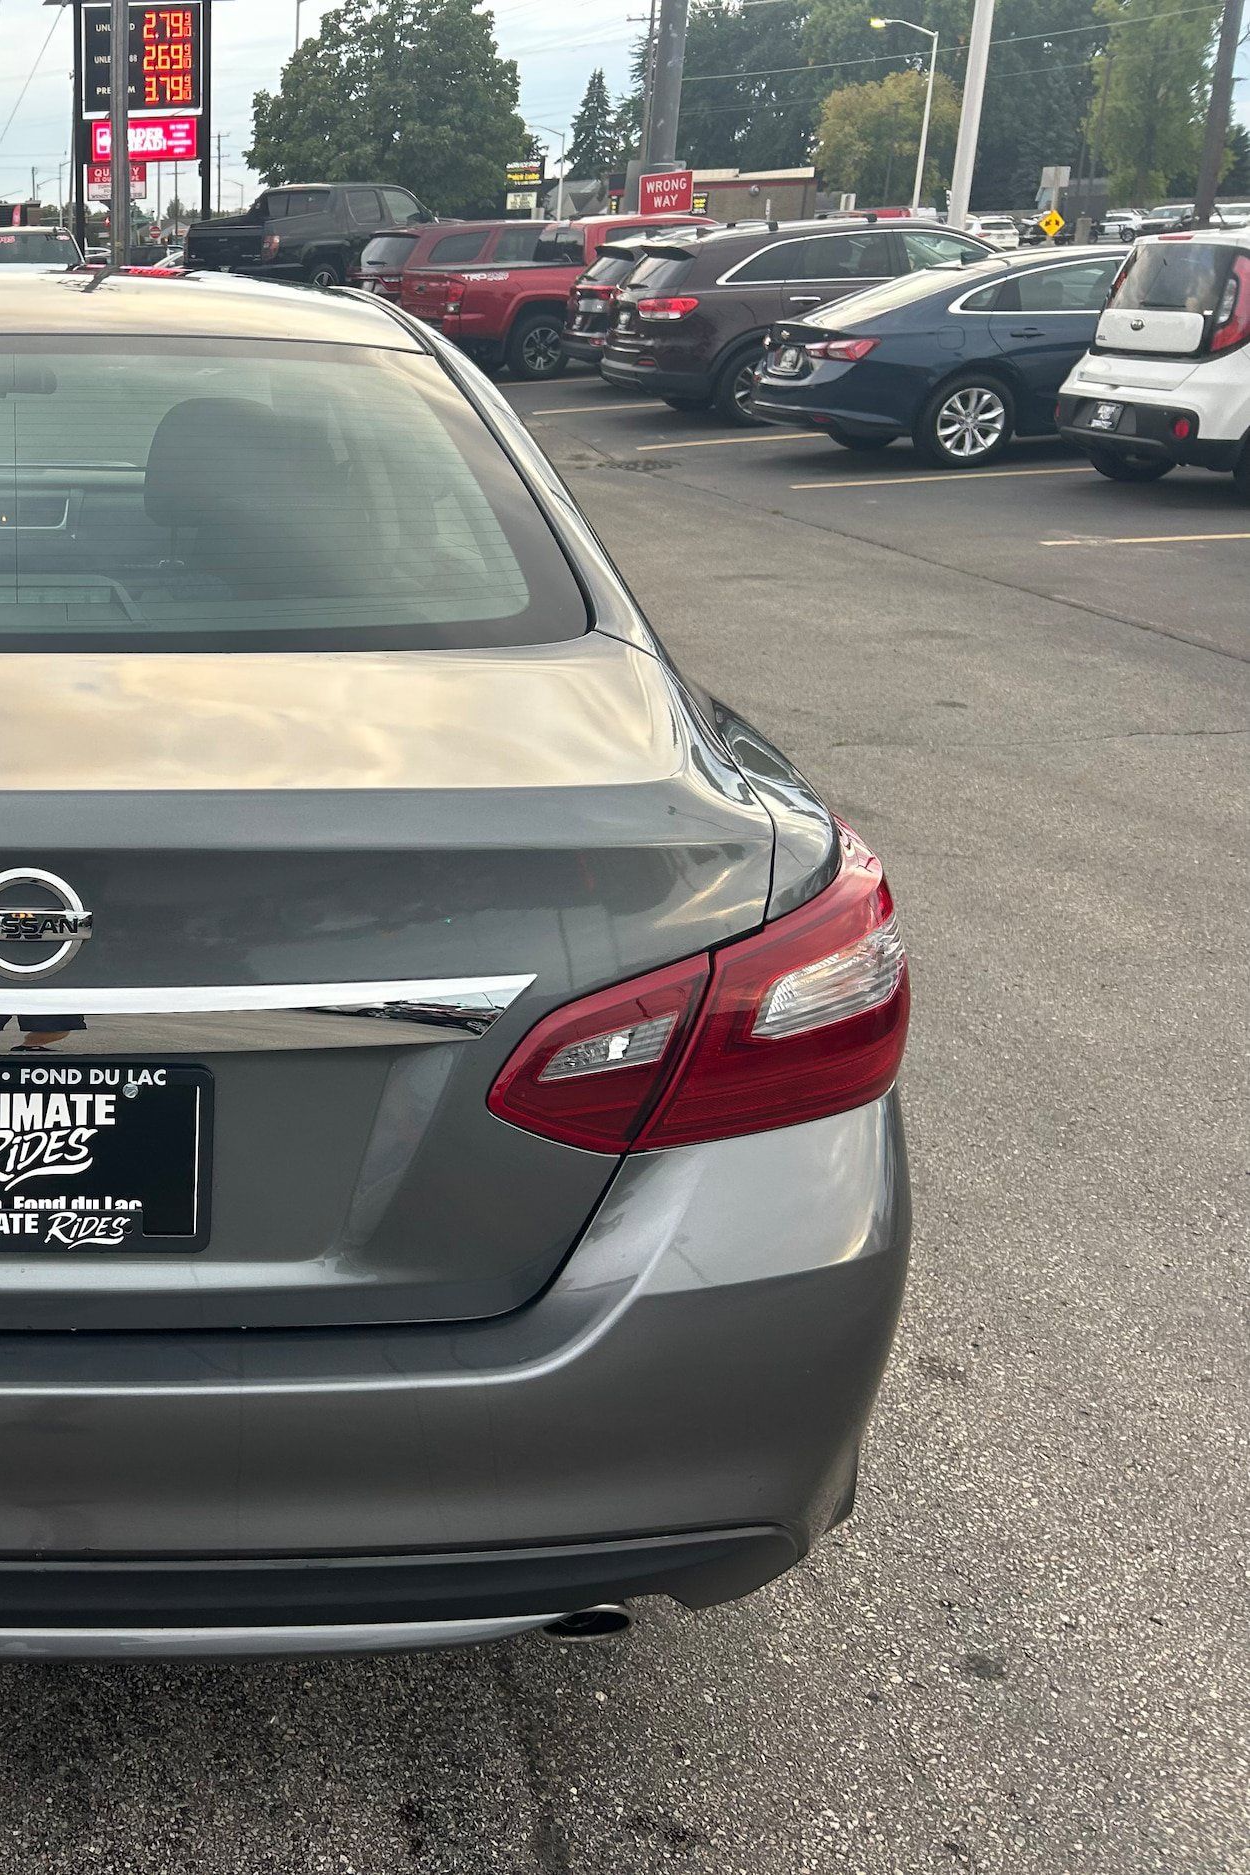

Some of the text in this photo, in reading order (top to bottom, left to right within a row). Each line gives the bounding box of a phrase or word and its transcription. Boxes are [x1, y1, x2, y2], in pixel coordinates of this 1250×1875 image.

[96, 23, 136, 32] UNLD
[143, 12, 183, 38] 2.79
[143, 45, 183, 70] 2.69
[96, 86, 136, 95] PREM
[144, 76, 183, 102] 3.79
[646, 178, 687, 194] WRONG
[653, 194, 678, 208] WAY
[20, 1068, 83, 1085] FOND
[89, 1069, 120, 1085] DU
[127, 1069, 167, 1086] LAC
[13, 1196, 67, 1209] Fond
